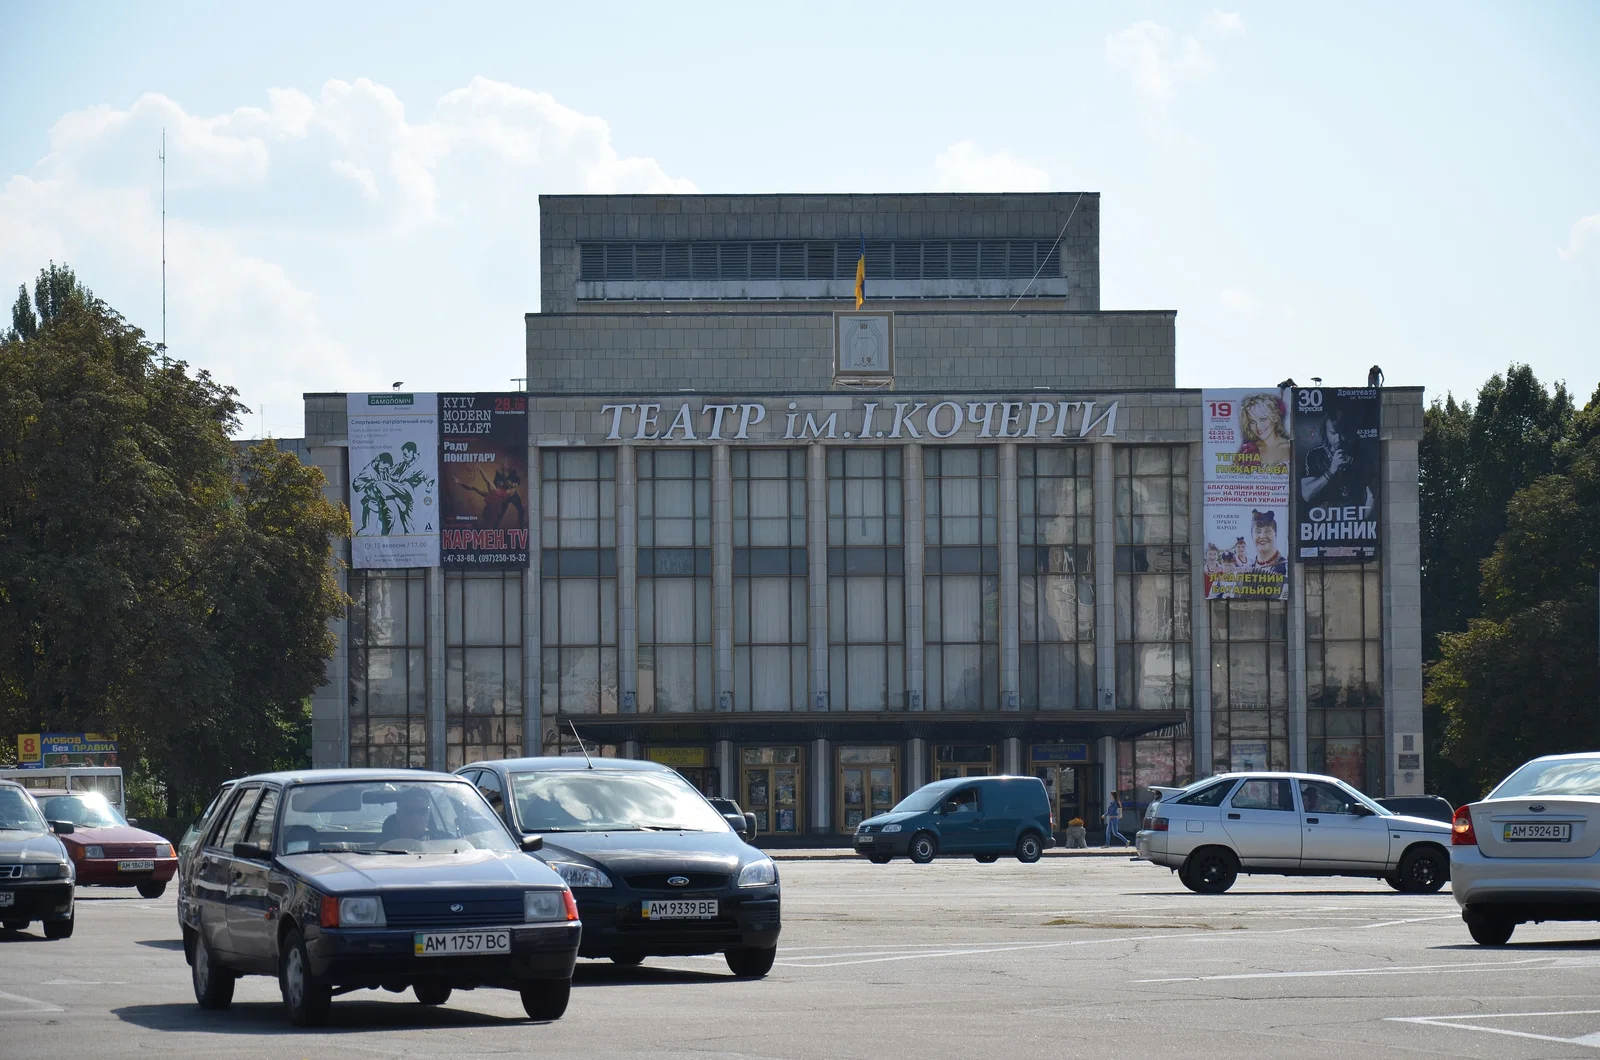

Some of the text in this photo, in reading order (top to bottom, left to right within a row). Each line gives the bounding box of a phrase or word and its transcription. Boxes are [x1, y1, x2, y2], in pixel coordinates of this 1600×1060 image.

[443, 397, 476, 408] KYIV
[1298, 389, 1323, 407] 30
[443, 410, 492, 421] MODERN
[1209, 402, 1232, 417] 19
[443, 422, 492, 434] BALLET
[600, 402, 766, 441] ТЕАТР
[443, 441, 468, 452] Раду
[443, 453, 496, 463] ПОКЛІТАРУ
[1215, 452, 1261, 462] ТЕТЯНА
[1309, 506, 1372, 522] ОЛЕГ
[1300, 521, 1378, 541] ВИННИК
[23, 738, 35, 752] 8
[1511, 826, 1526, 836] AM
[1528, 826, 1551, 836] 5924
[650, 902, 716, 915] AM 9339 BE
[425, 934, 508, 951] AM 1757 BC
